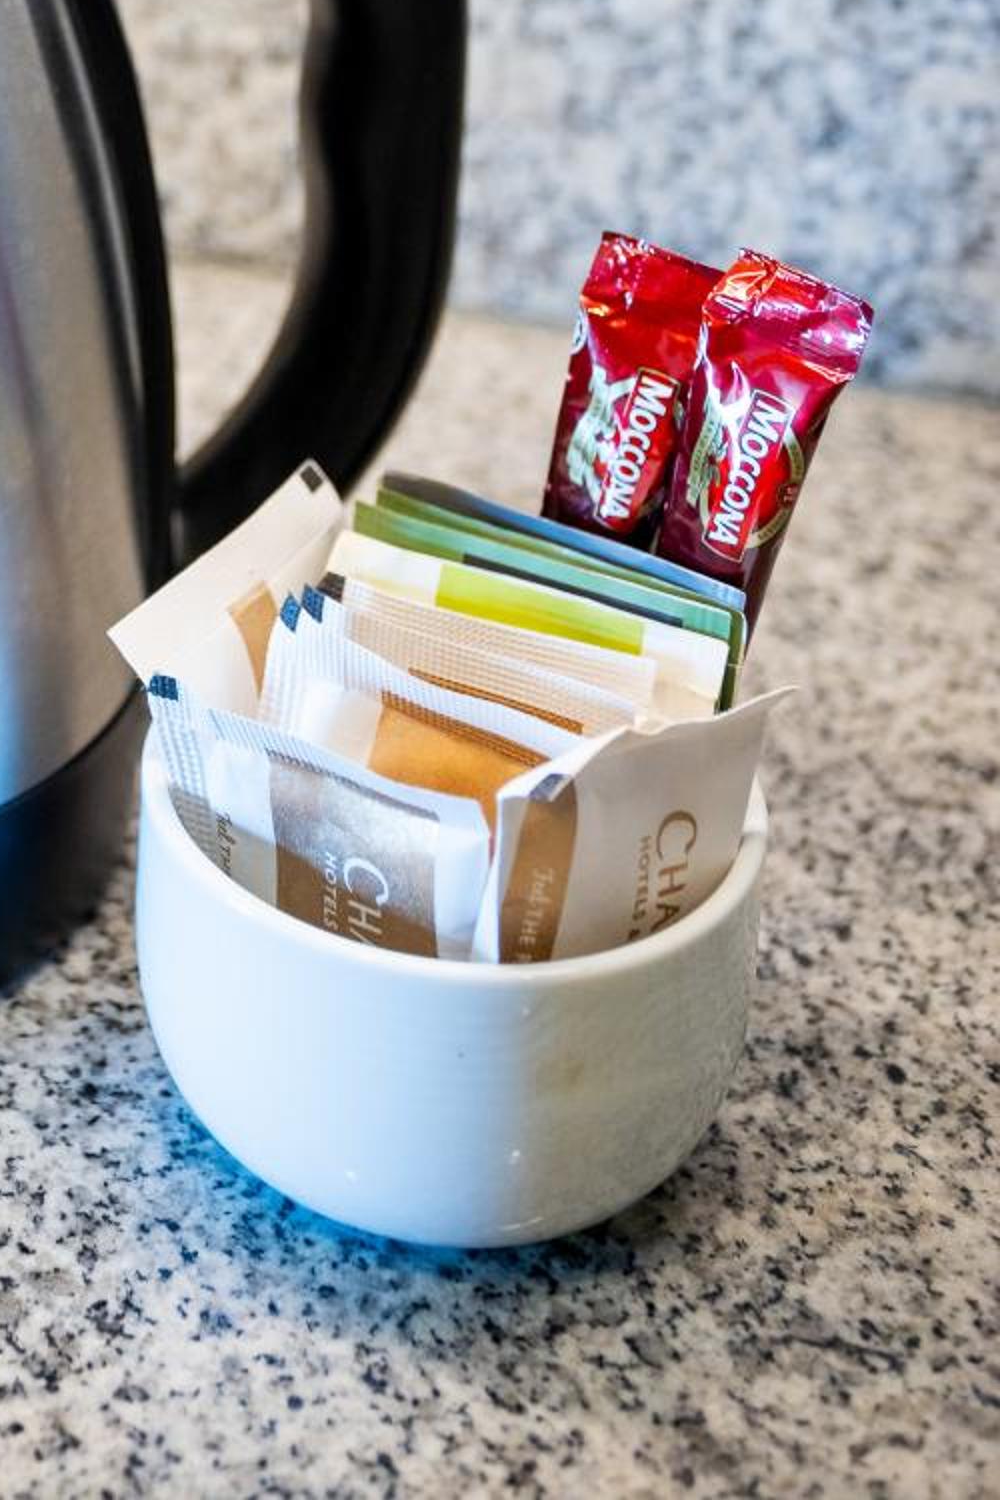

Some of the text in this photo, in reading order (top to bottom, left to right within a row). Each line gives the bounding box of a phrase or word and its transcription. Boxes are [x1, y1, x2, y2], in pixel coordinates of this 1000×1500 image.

[708, 399, 787, 545] MOCCONA
[323, 851, 339, 930] HOTELS
[632, 836, 650, 920] HOTELS
[650, 810, 697, 932] CHA
